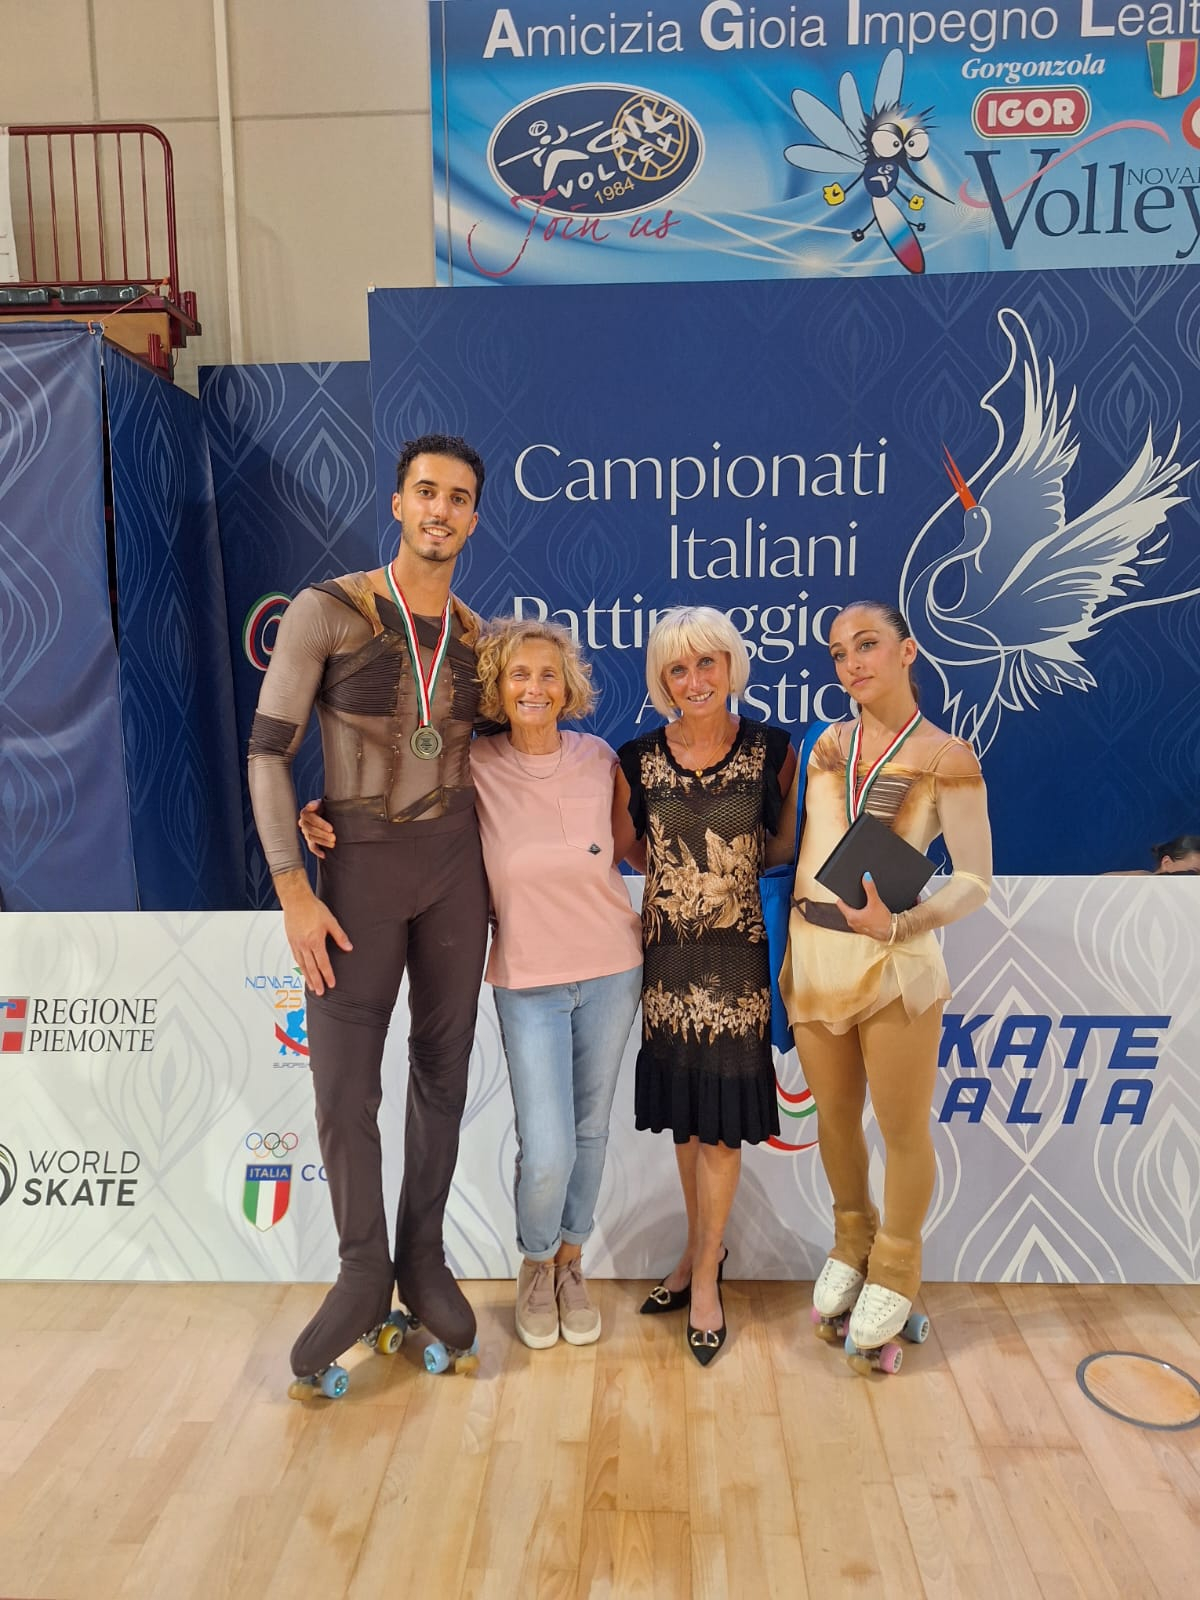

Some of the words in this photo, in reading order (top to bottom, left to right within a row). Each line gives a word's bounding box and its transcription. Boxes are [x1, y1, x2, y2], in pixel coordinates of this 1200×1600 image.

[483, 8, 684, 59] Amicizia
[699, 0, 827, 51] Gioia
[847, 0, 1058, 54] Impegno
[961, 54, 1106, 84] Gorgonzola
[987, 98, 1076, 127] IGOR
[557, 133, 673, 198] VOLLEY
[1127, 167, 1200, 185] NOVA
[594, 176, 636, 204] 1984
[964, 148, 1200, 259] Volley
[467, 188, 611, 278] Join
[628, 210, 681, 240] us
[514, 437, 888, 516] Campionati
[670, 517, 859, 580] Italiani
[244, 975, 303, 989] NOVARA
[31, 998, 158, 1025] REGIONE
[274, 989, 303, 1009] 25
[29, 1029, 155, 1052] PIEMONTE
[937, 1014, 1172, 1070] KATE
[938, 1077, 1154, 1125] ALIA
[29, 1150, 141, 1174] WORLD
[249, 1167, 290, 1179] ITALIA
[22, 1178, 138, 1206] SKATE
